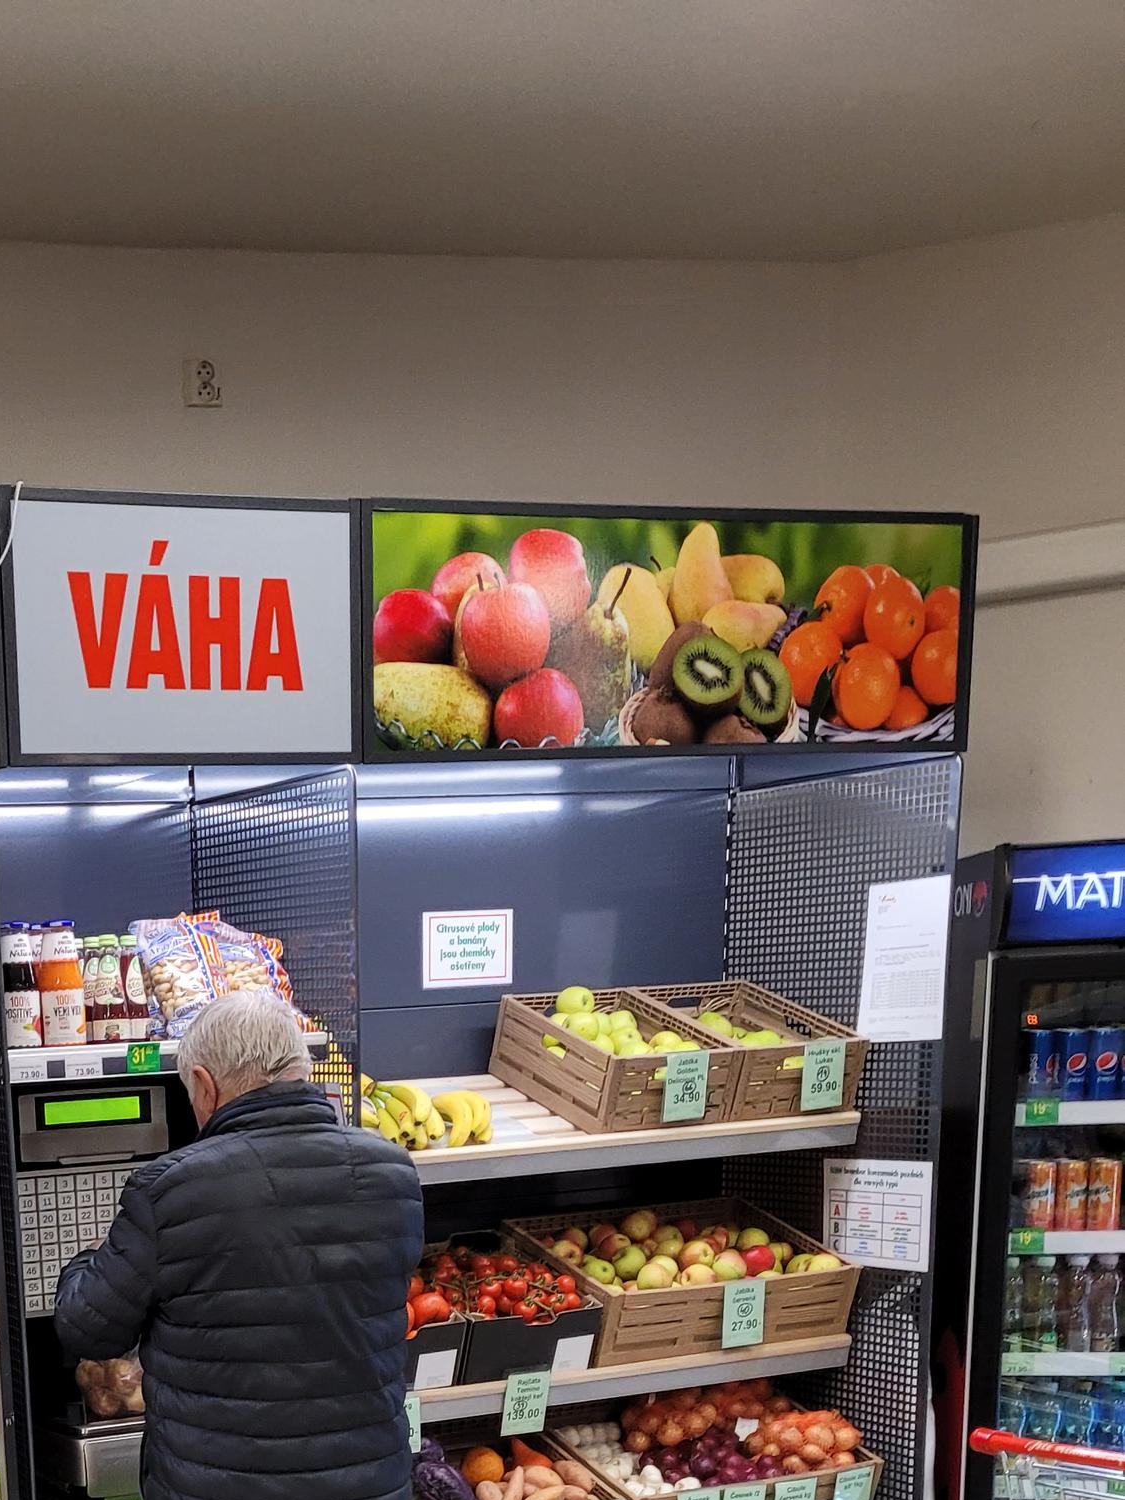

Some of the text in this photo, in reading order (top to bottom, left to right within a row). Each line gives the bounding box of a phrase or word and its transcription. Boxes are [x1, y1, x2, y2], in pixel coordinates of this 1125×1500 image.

[68, 540, 303, 692] VÁHA
[436, 920, 501, 935] Citrusové plody
[449, 935, 488, 947] a banány
[440, 946, 496, 961] jsou chemicky
[450, 960, 486, 972] ošetřeny
[131, 1047, 145, 1064] 31
[815, 1056, 833, 1065] Lukas
[20, 1071, 40, 1079] 73.90
[75, 1068, 95, 1076] 73.90
[676, 1066, 699, 1075] Golden
[810, 1081, 837, 1094] 59.90
[673, 1091, 700, 1104] 34.90
[82, 1228, 93, 1236] 31
[26, 1246, 75, 1258] 37 38 39
[26, 1264, 56, 1275] 46 47
[28, 1283, 39, 1291] 55
[28, 1299, 39, 1308] 64
[731, 1319, 758, 1332] 27.90
[517, 1378, 541, 1386] Rajčata
[506, 1408, 540, 1421] 139.00
[730, 1490, 753, 1500] Česnek
